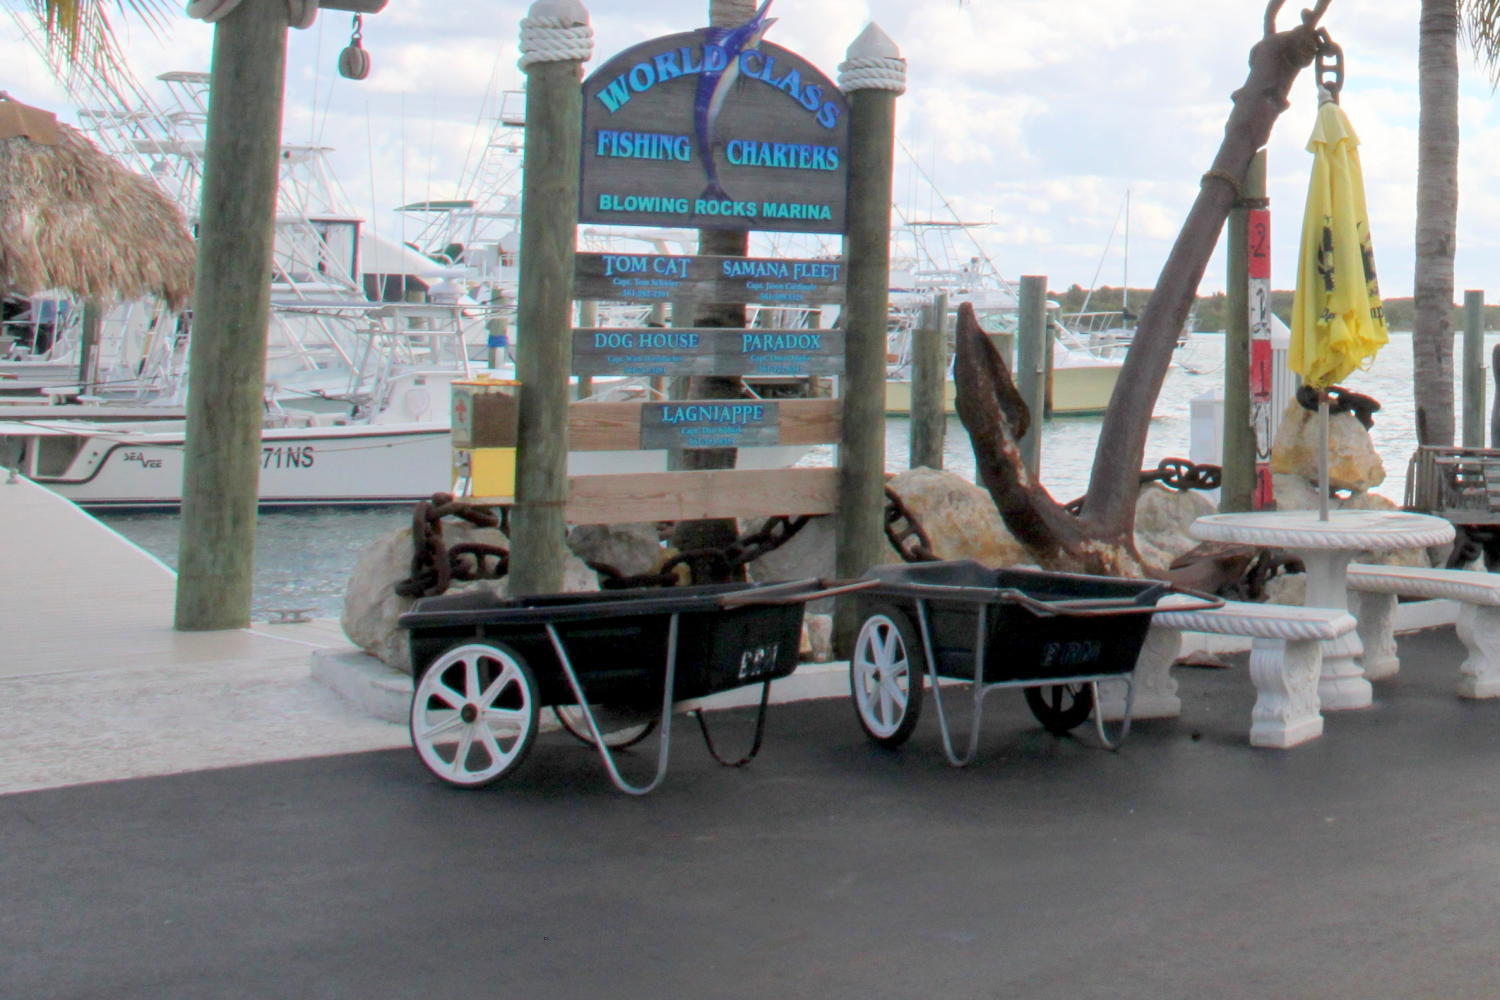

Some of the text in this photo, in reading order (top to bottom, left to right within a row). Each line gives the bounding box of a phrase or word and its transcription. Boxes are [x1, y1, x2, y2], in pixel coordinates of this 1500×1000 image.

[596, 44, 842, 130] WORLD CLASS
[595, 130, 840, 171] FISHING CHARTERS
[598, 194, 833, 220] BLOWING ROCKS MARINA
[603, 255, 691, 278] TOM CAT
[723, 261, 841, 282] SAMANA FLEET
[594, 333, 701, 349] DOG HOUSE
[742, 333, 821, 353] PARADOX
[662, 405, 764, 424] LAGNIAPPE
